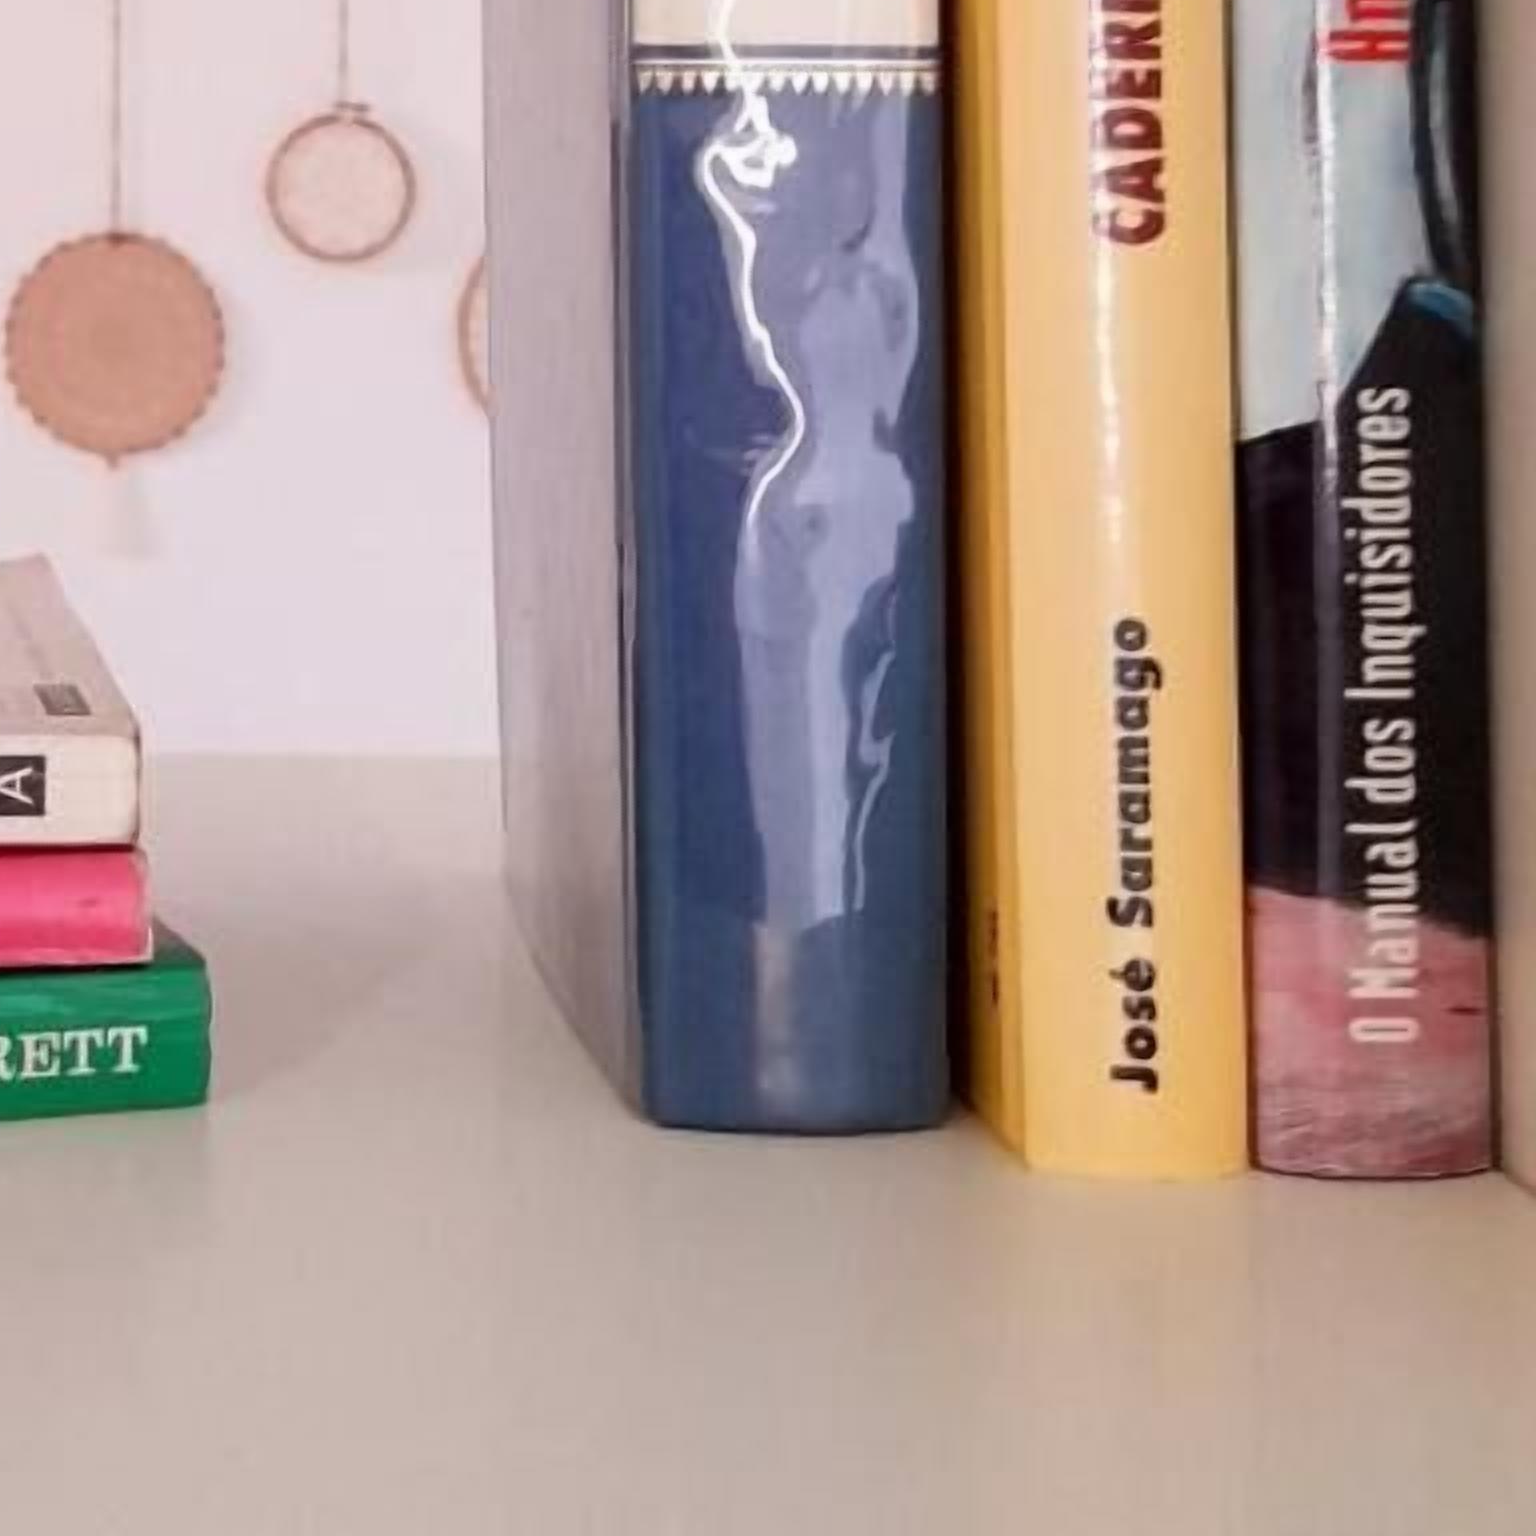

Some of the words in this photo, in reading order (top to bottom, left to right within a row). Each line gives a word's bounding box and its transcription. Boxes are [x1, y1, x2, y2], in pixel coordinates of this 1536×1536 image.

[1341, 385, 1429, 701] Inquisidores
[1107, 615, 1164, 928] Saramago
[1344, 716, 1417, 802] dos
[1345, 819, 1421, 1002] Manual
[1109, 958, 1159, 1093] José
[1349, 1018, 1420, 1044] O
